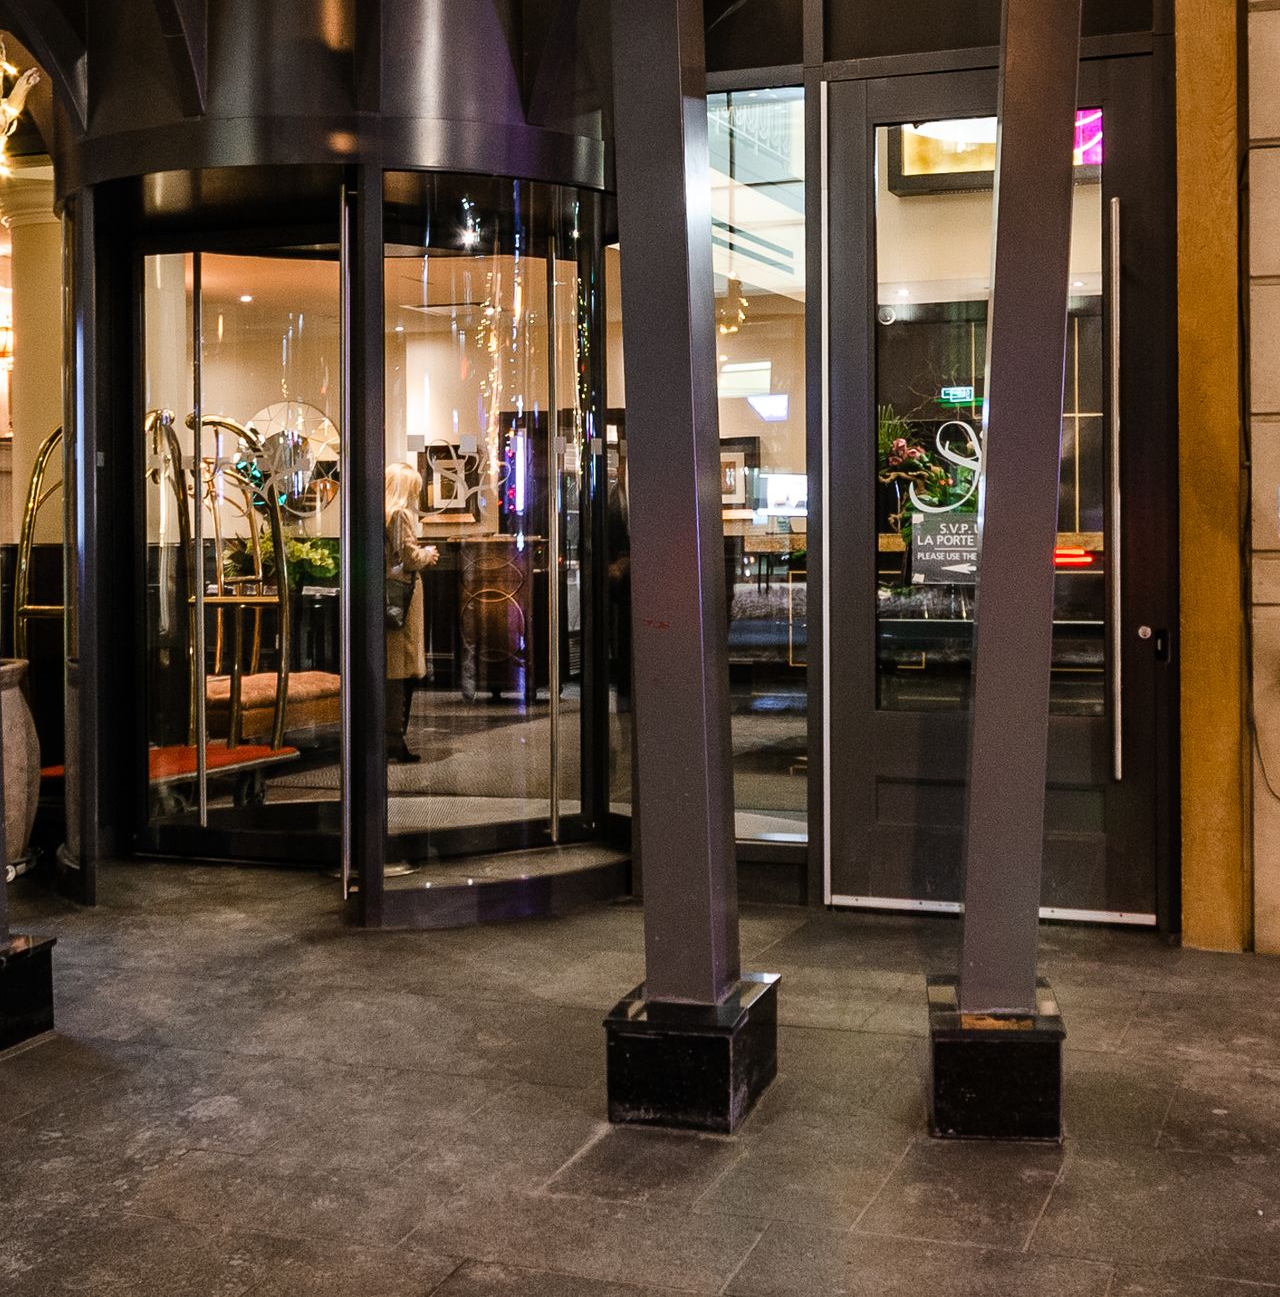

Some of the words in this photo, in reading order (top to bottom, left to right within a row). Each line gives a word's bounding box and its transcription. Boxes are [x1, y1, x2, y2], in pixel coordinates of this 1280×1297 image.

[939, 522, 971, 534] S.V.P.
[917, 535, 934, 546] LA
[936, 535, 975, 546] PORTE
[917, 552, 945, 561] PLEASE
[946, 552, 961, 561] USE
[962, 552, 978, 561] THE
